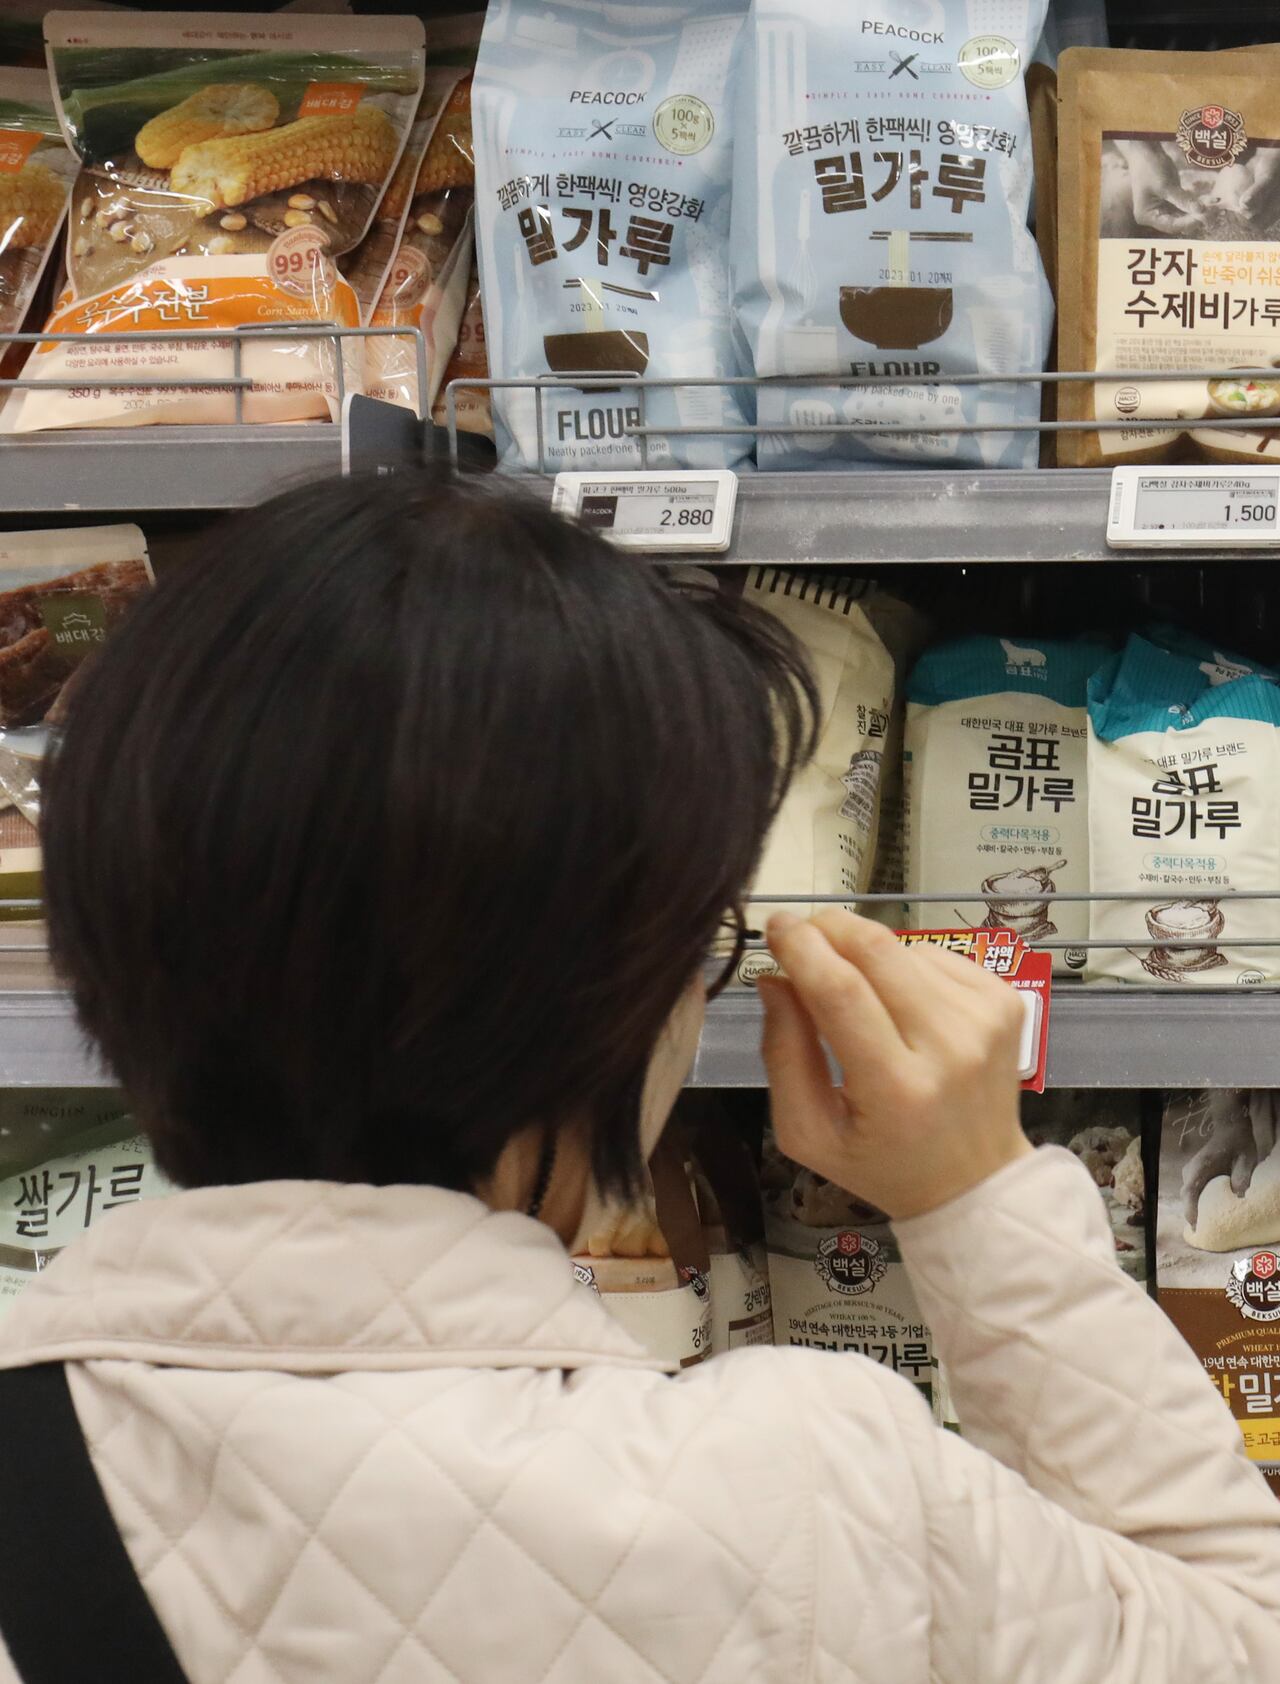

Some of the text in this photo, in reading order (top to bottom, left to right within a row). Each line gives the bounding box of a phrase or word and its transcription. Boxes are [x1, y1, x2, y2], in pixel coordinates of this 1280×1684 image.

[861, 21, 944, 44] PEACOCK
[570, 91, 647, 105] PEACOCK
[1195, 131, 1228, 149] 백설
[814, 150, 987, 214] 밀가루
[517, 204, 675, 275] 밀가루
[1128, 248, 1198, 286] 감자
[68, 387, 90, 398] 350
[908, 391, 924, 400] one
[928, 393, 939, 403] by
[943, 394, 959, 405] one
[558, 408, 640, 440] FLOUR
[548, 443, 578, 457] Neatly
[580, 442, 613, 457] packed
[615, 442, 633, 455] one
[968, 773, 1075, 812] 밀가루
[1132, 797, 1241, 840] 밀가루
[985, 946, 1014, 958] 차액
[984, 959, 1011, 972] 보상
[576, 1269, 590, 1282] 1953
[833, 1258, 865, 1276] 백설
[789, 1319, 923, 1338] 19년 연속 대한민국 1등 기업
